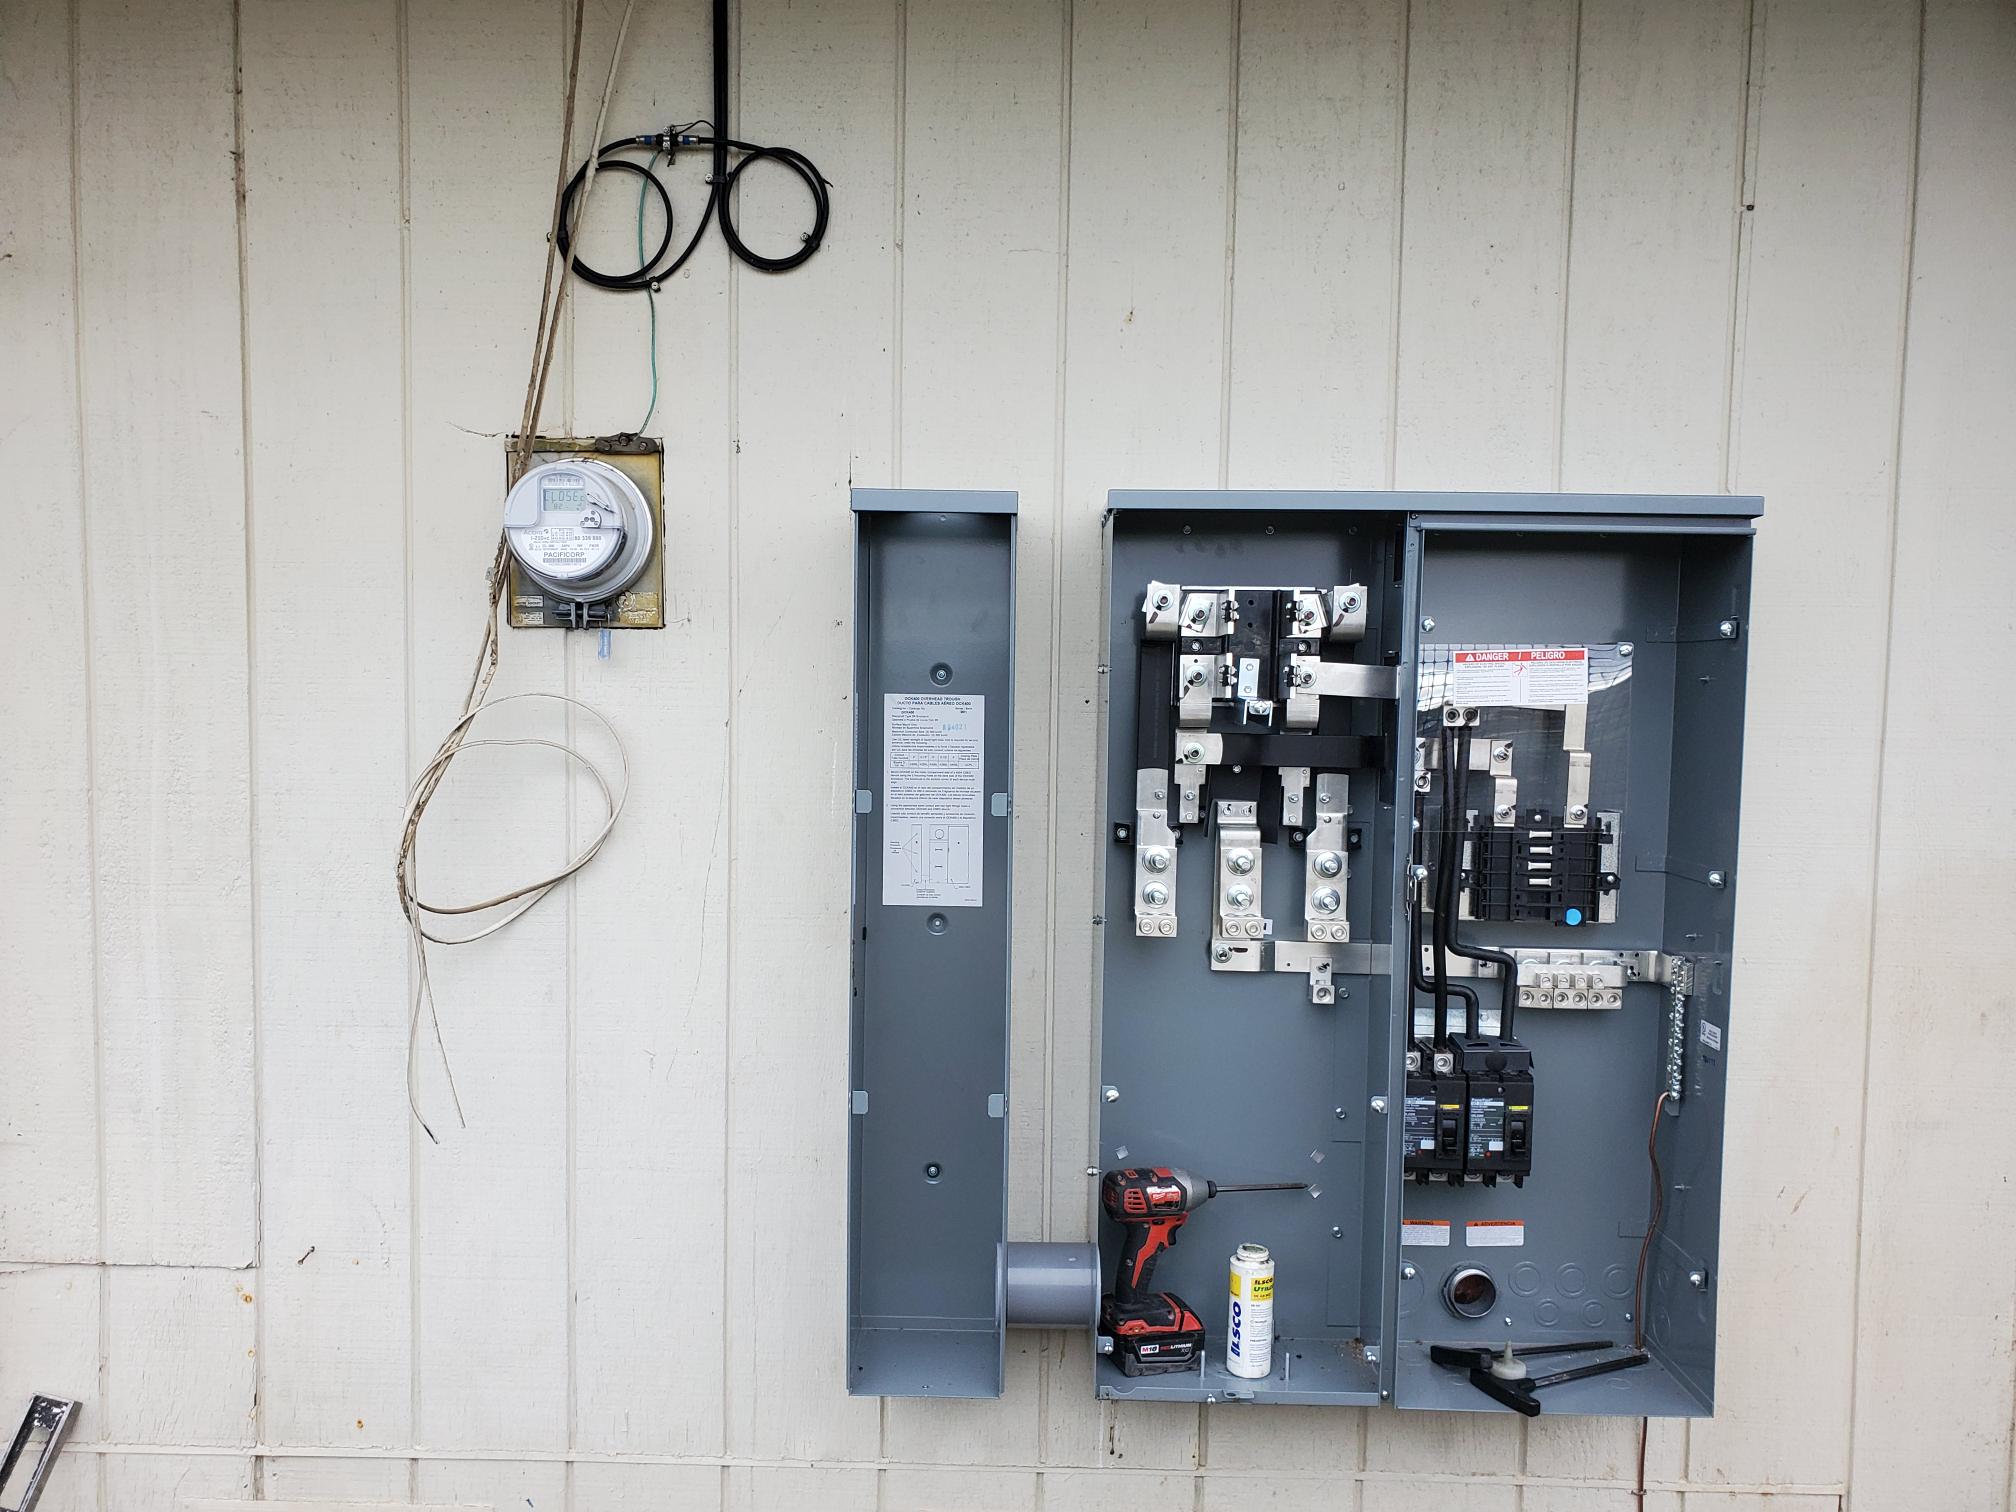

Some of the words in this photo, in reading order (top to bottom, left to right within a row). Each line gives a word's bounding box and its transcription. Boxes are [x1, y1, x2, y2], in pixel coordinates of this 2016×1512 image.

[1475, 652, 1509, 661] DANGER
[1530, 651, 1566, 660] PELIGRO
[1230, 1301, 1242, 1358] ILSCO
[1141, 1345, 1158, 1353] M18
